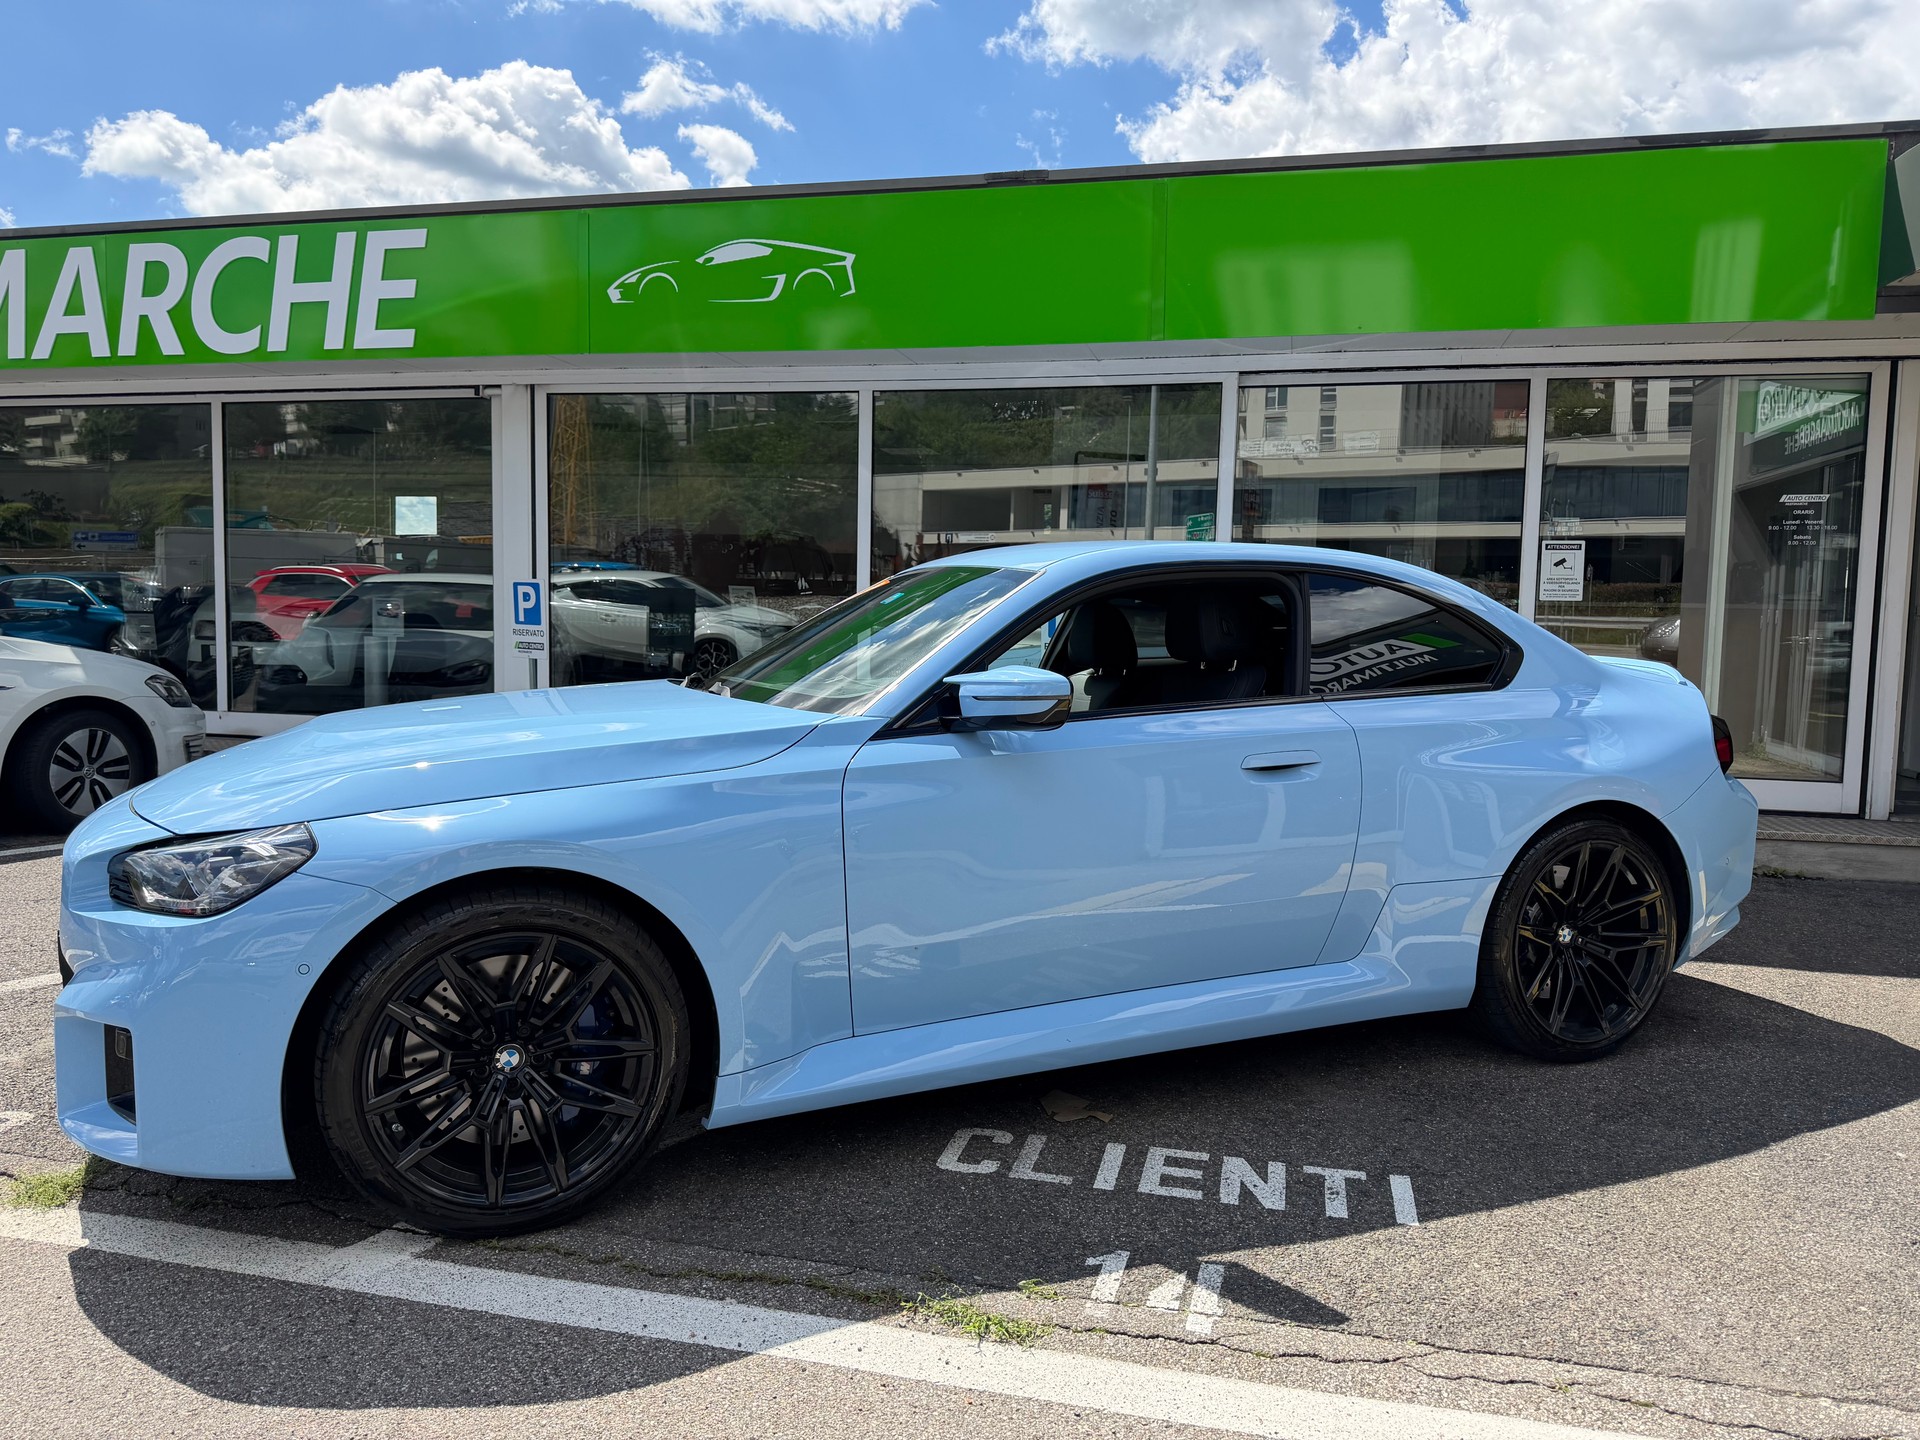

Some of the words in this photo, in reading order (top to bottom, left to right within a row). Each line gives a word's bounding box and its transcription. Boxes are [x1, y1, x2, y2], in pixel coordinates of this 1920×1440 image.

[512, 628, 545, 638] RISERVATO
[517, 585, 537, 622] P
[936, 1127, 1421, 1227] CLIENTI
[1085, 1249, 1227, 1335] 14
